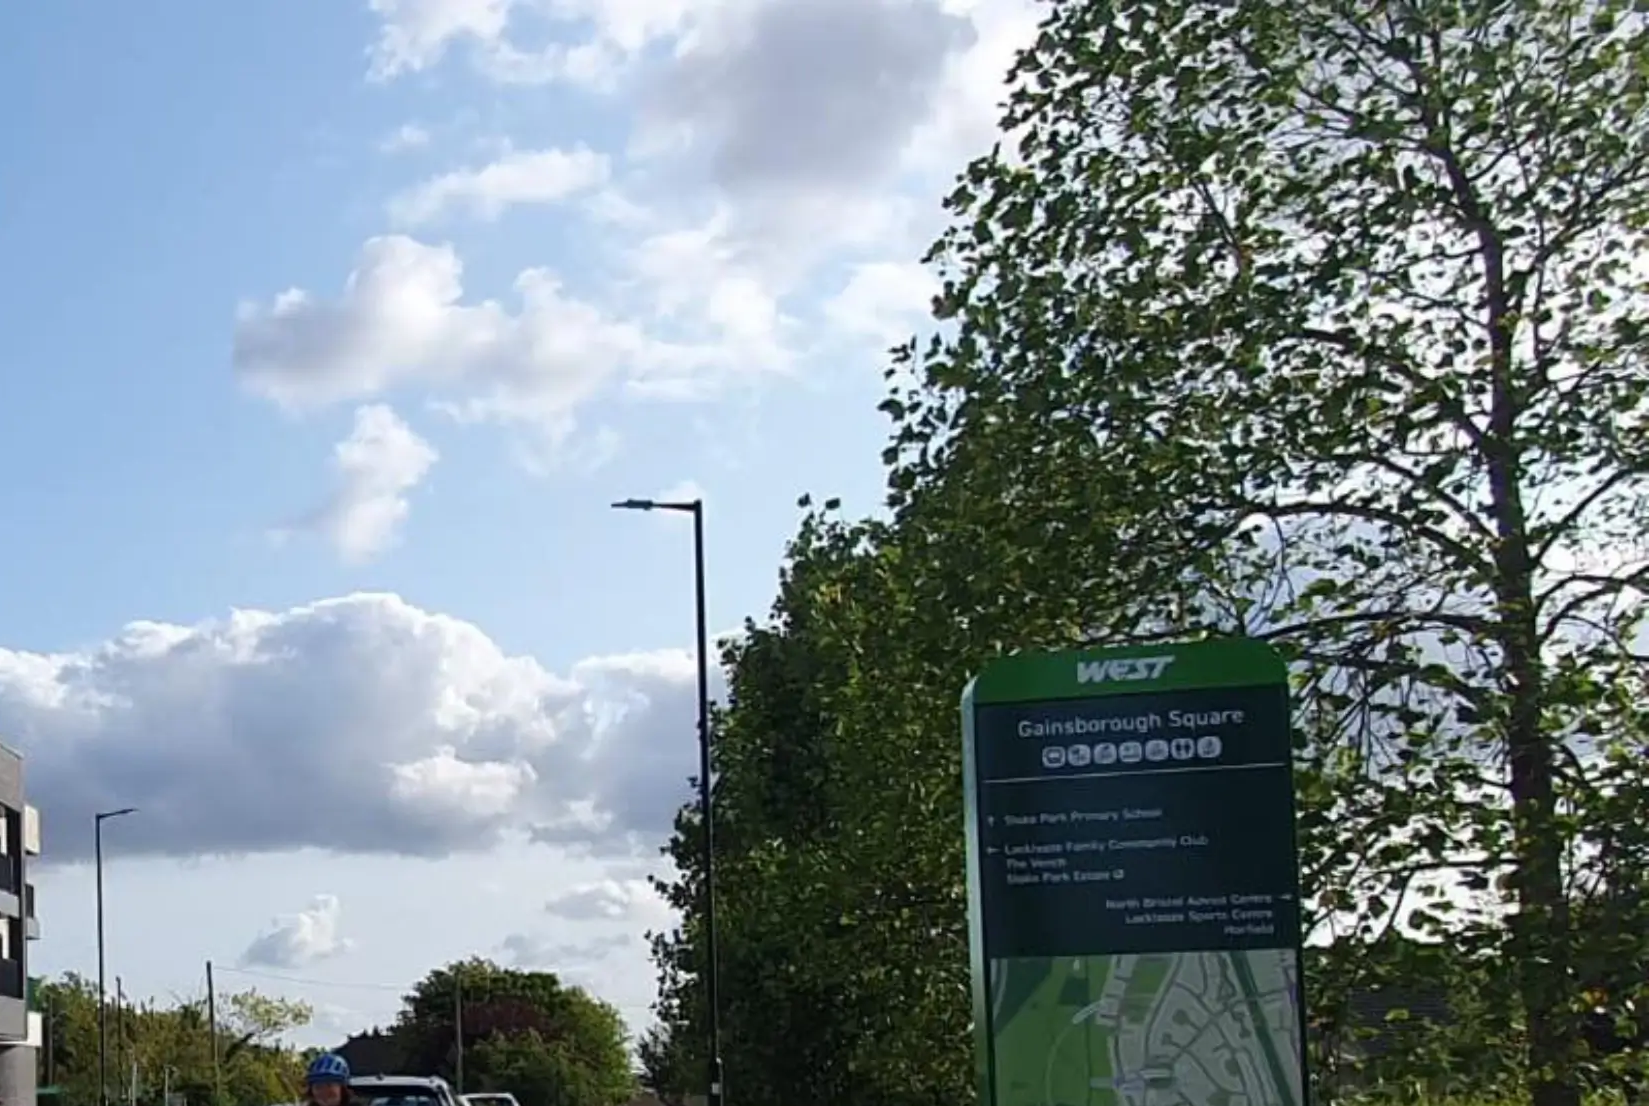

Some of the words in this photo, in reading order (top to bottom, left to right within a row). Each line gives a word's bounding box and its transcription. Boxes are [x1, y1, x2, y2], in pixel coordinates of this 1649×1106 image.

[1017, 713, 1161, 737] Gainsborough
[1168, 710, 1245, 731] Square
[1122, 807, 1163, 821] School
[1180, 834, 1209, 847] Club
[1043, 871, 1070, 883] Park
